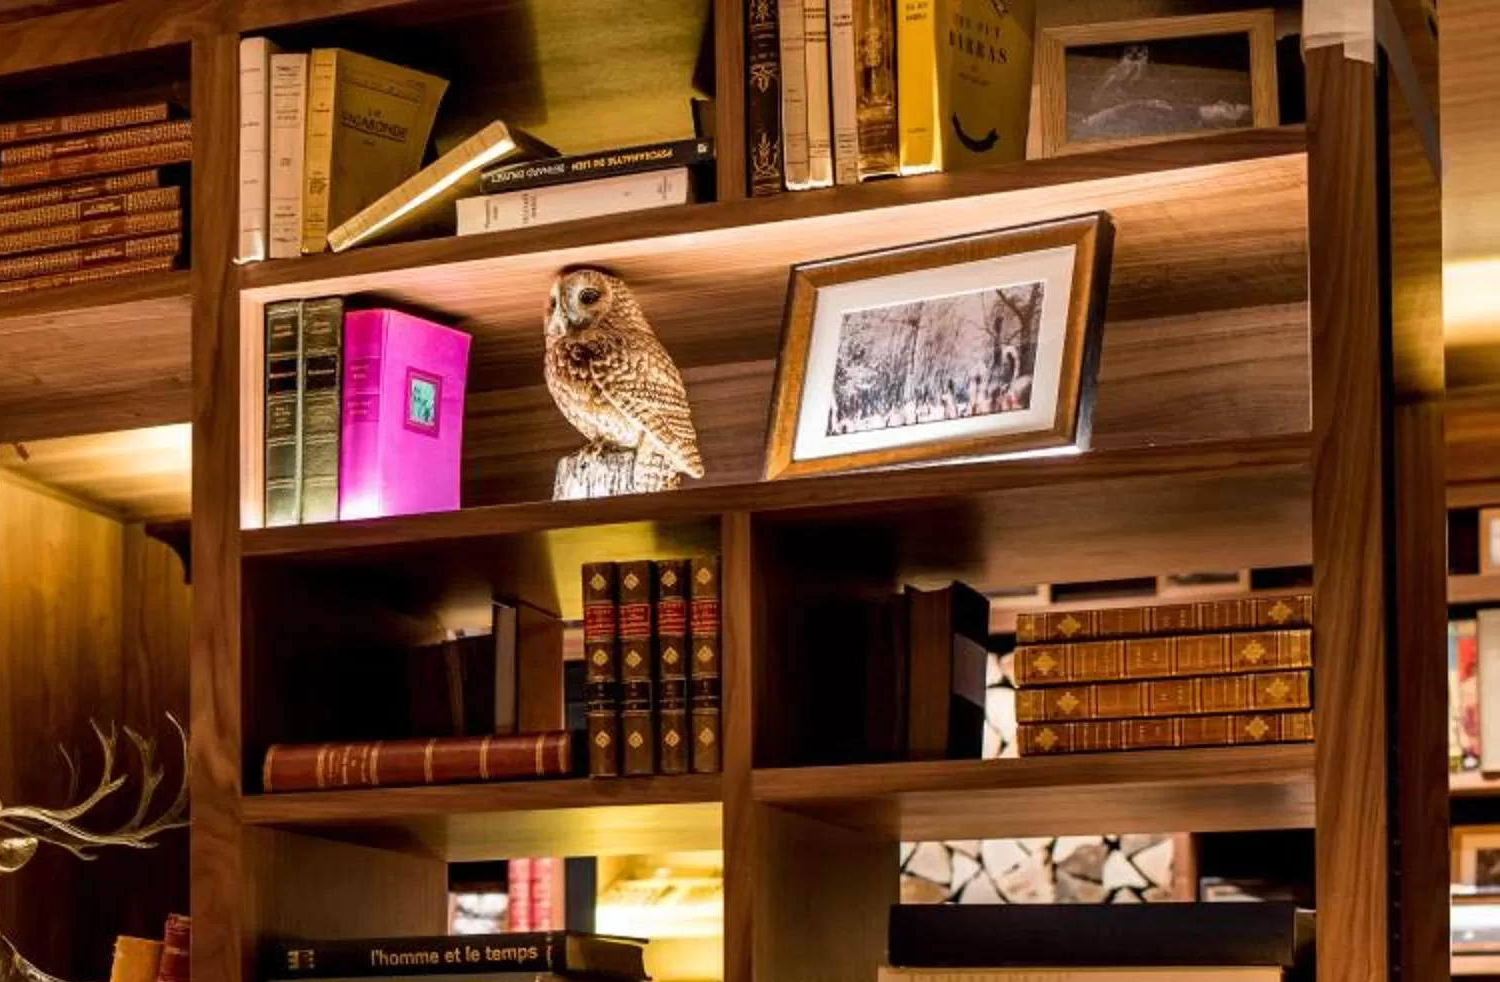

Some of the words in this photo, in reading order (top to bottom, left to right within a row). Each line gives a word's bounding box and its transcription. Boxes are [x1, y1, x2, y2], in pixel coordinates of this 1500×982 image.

[371, 949, 440, 967] l'homme
[444, 948, 461, 963] et
[465, 946, 480, 962] le
[485, 945, 539, 964] temps
